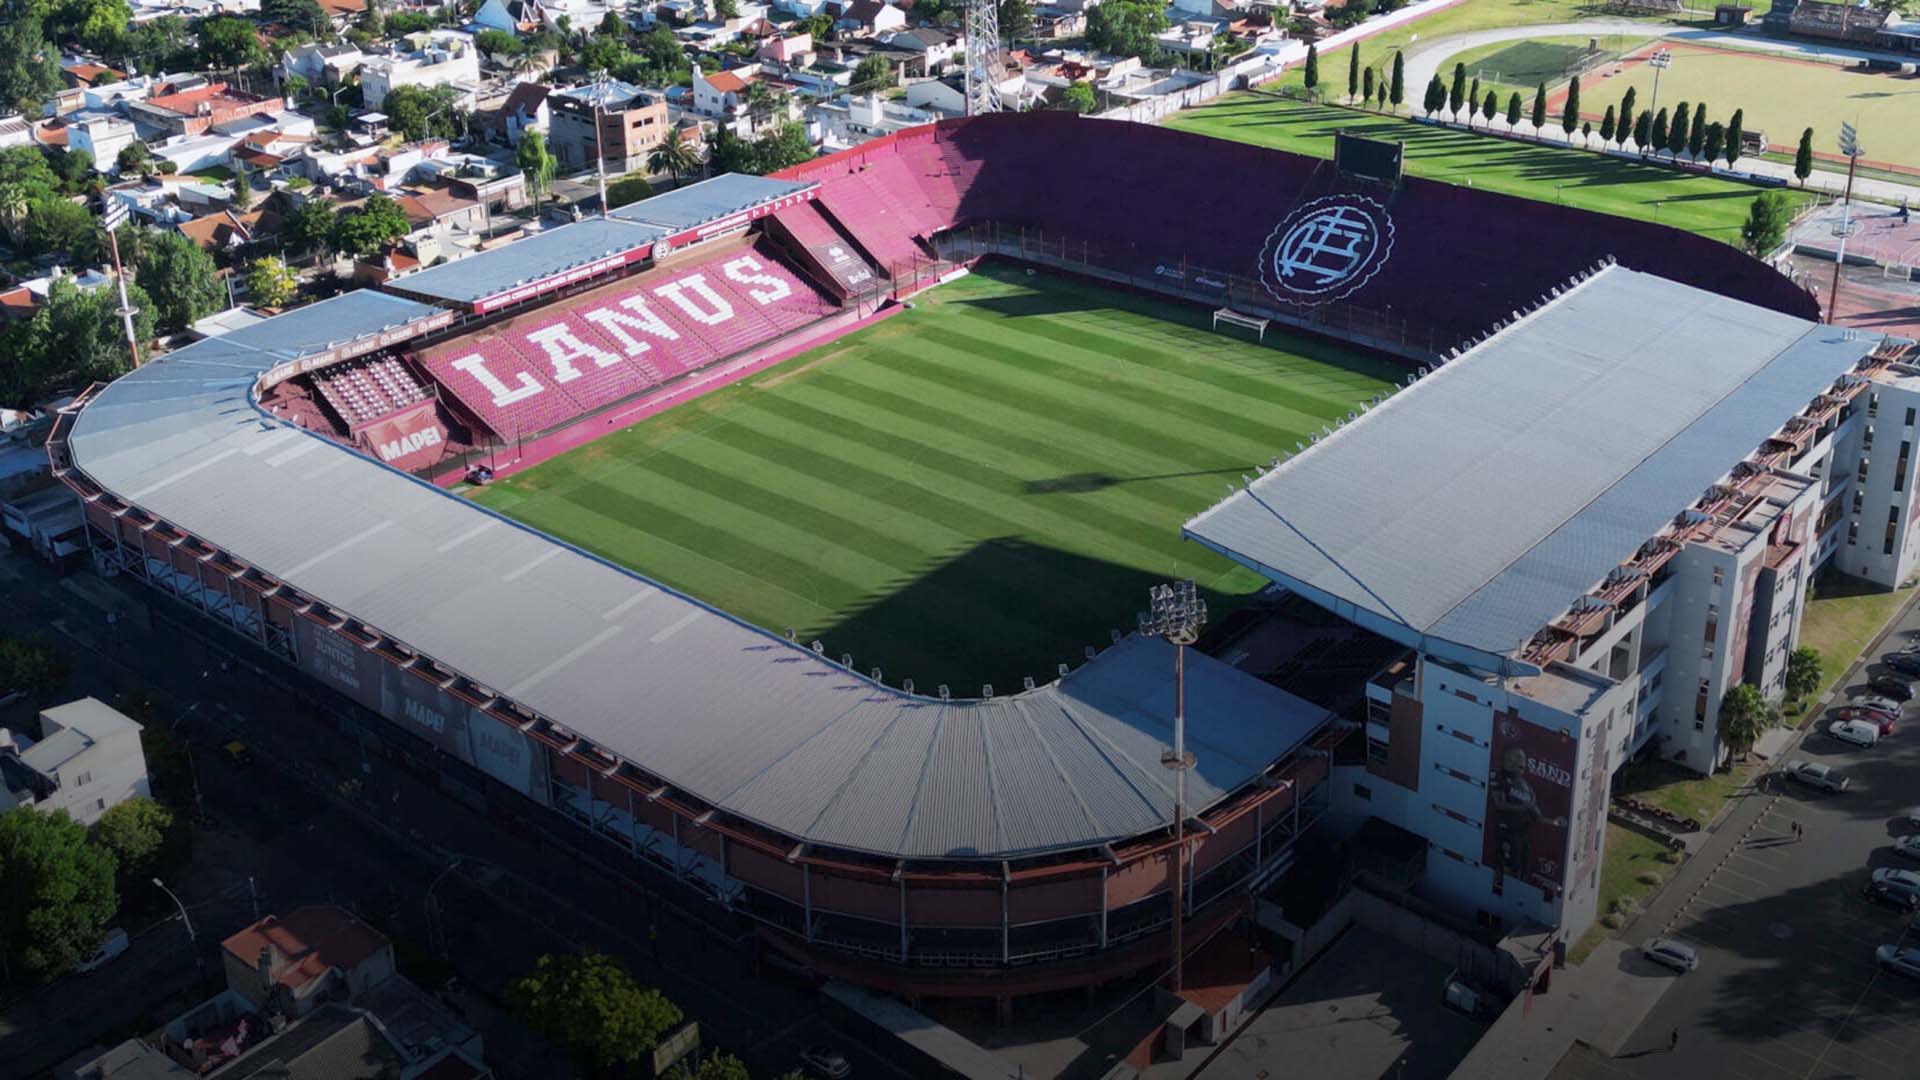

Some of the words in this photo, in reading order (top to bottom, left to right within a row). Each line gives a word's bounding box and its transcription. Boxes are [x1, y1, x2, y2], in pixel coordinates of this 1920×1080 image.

[451, 255, 793, 407] LANUS
[380, 425, 442, 461] MAPEI
[405, 698, 446, 734] MAPEI
